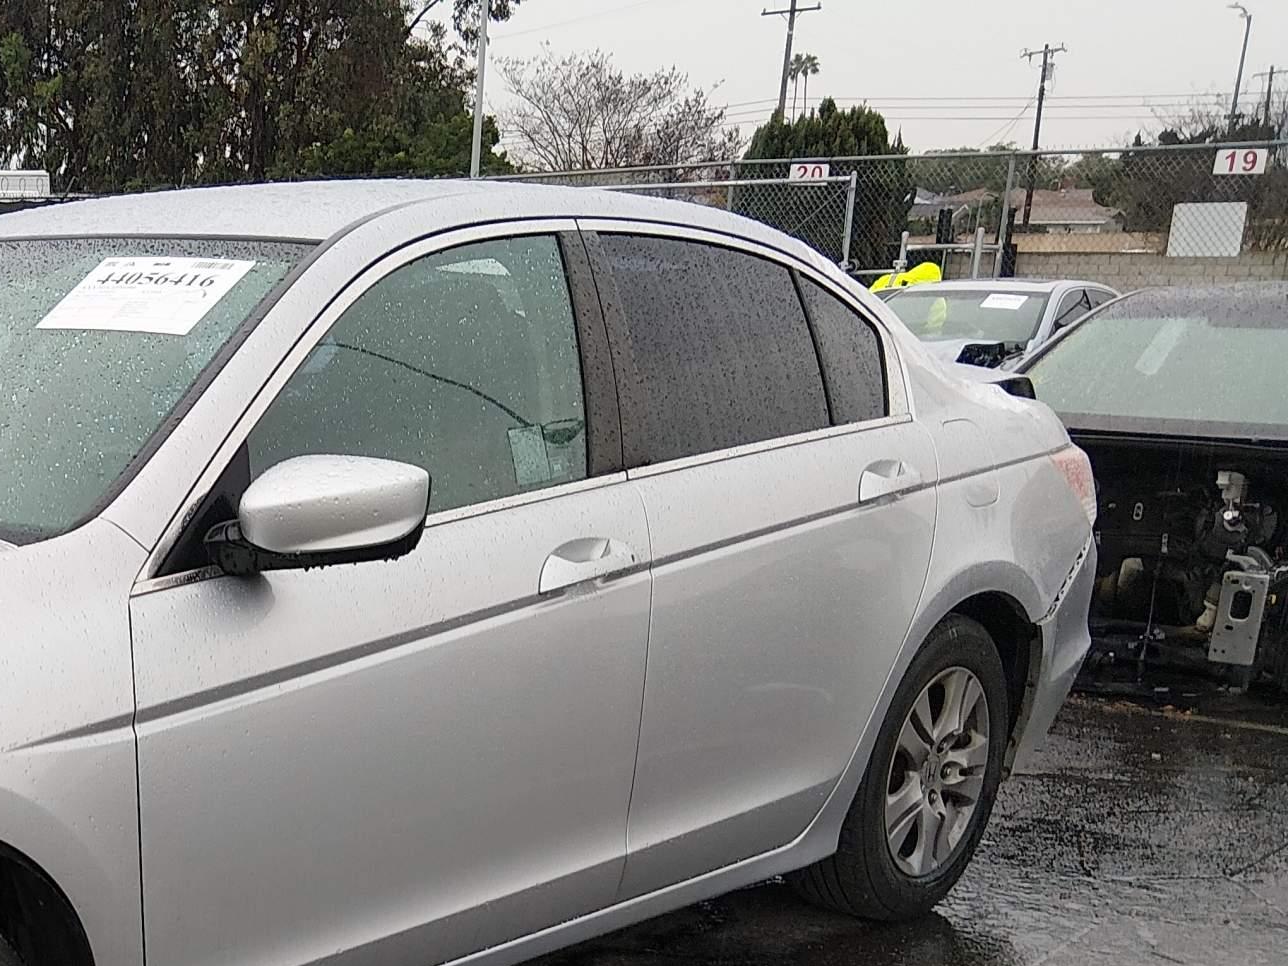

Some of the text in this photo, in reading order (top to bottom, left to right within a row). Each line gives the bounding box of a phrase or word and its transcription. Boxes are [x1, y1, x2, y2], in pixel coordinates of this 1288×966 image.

[1225, 150, 1258, 172] 19
[797, 165, 823, 179] 20
[96, 272, 220, 287] 44056416
